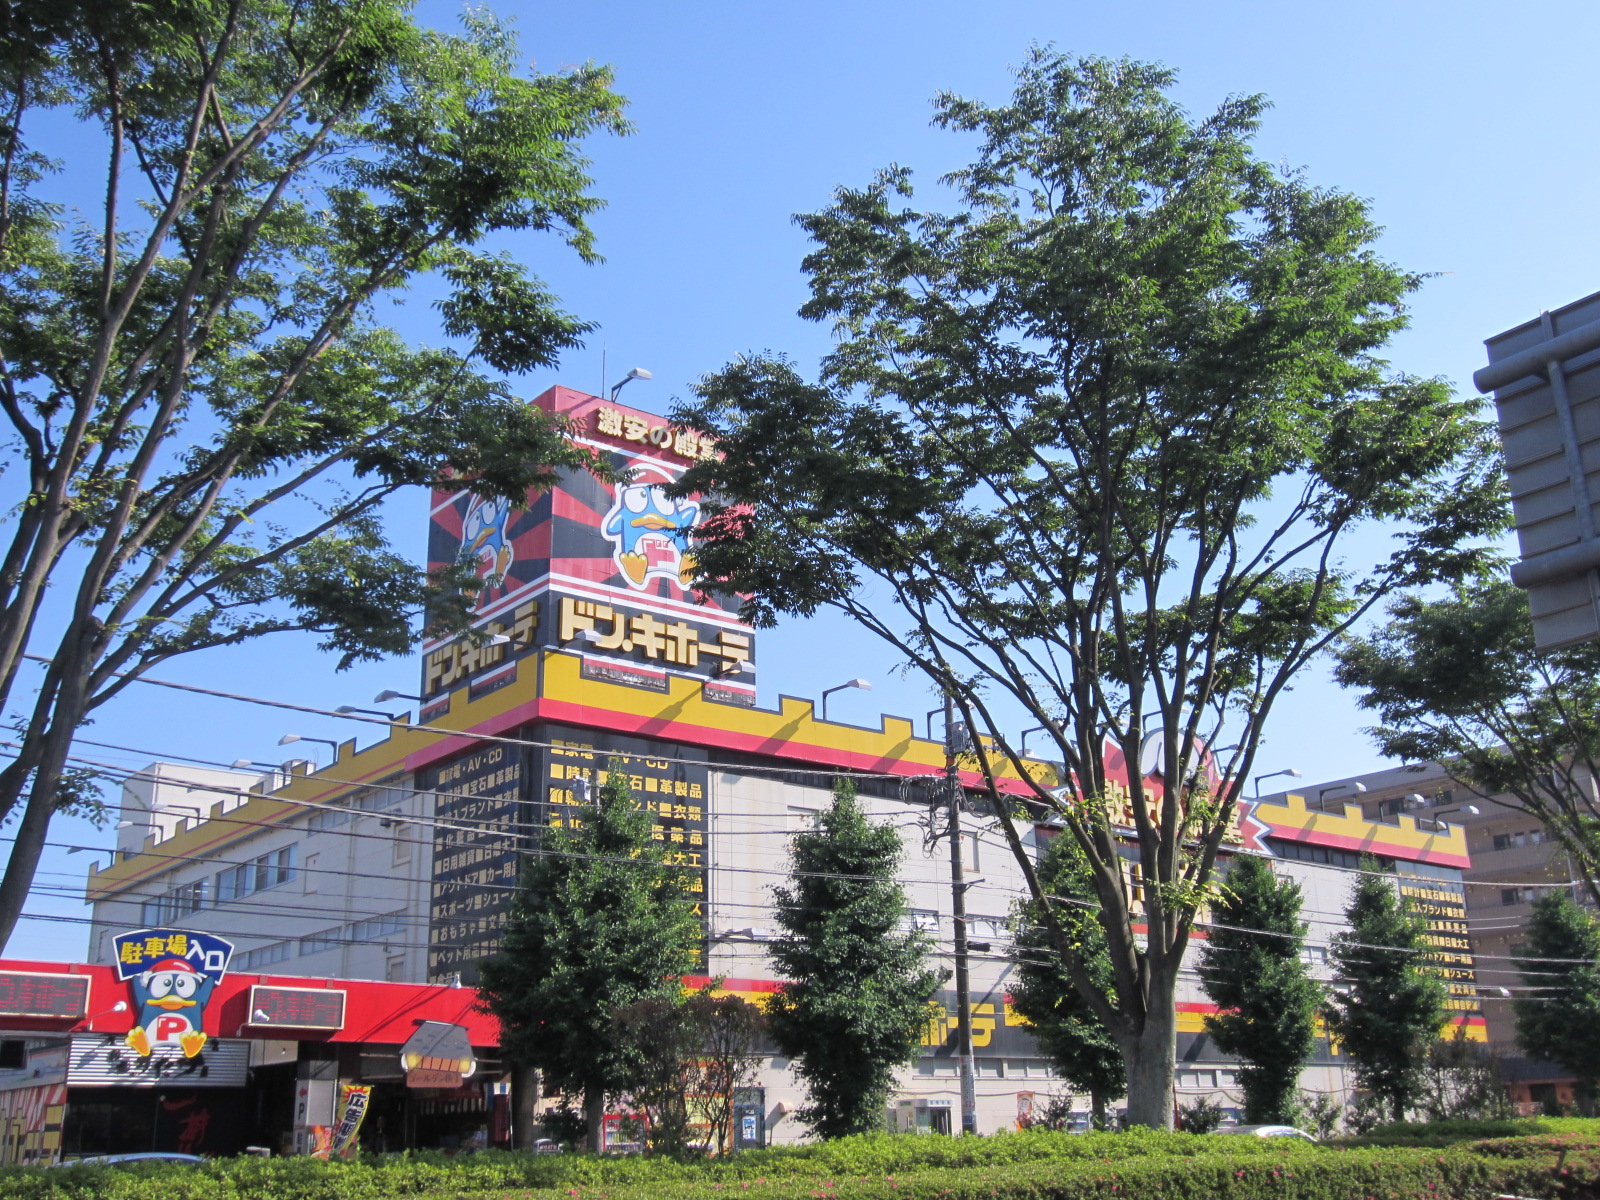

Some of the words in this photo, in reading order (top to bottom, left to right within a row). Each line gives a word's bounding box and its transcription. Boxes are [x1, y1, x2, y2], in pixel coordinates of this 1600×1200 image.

[121, 934, 225, 972] 駐車場入口
[156, 1017, 188, 1042] P
